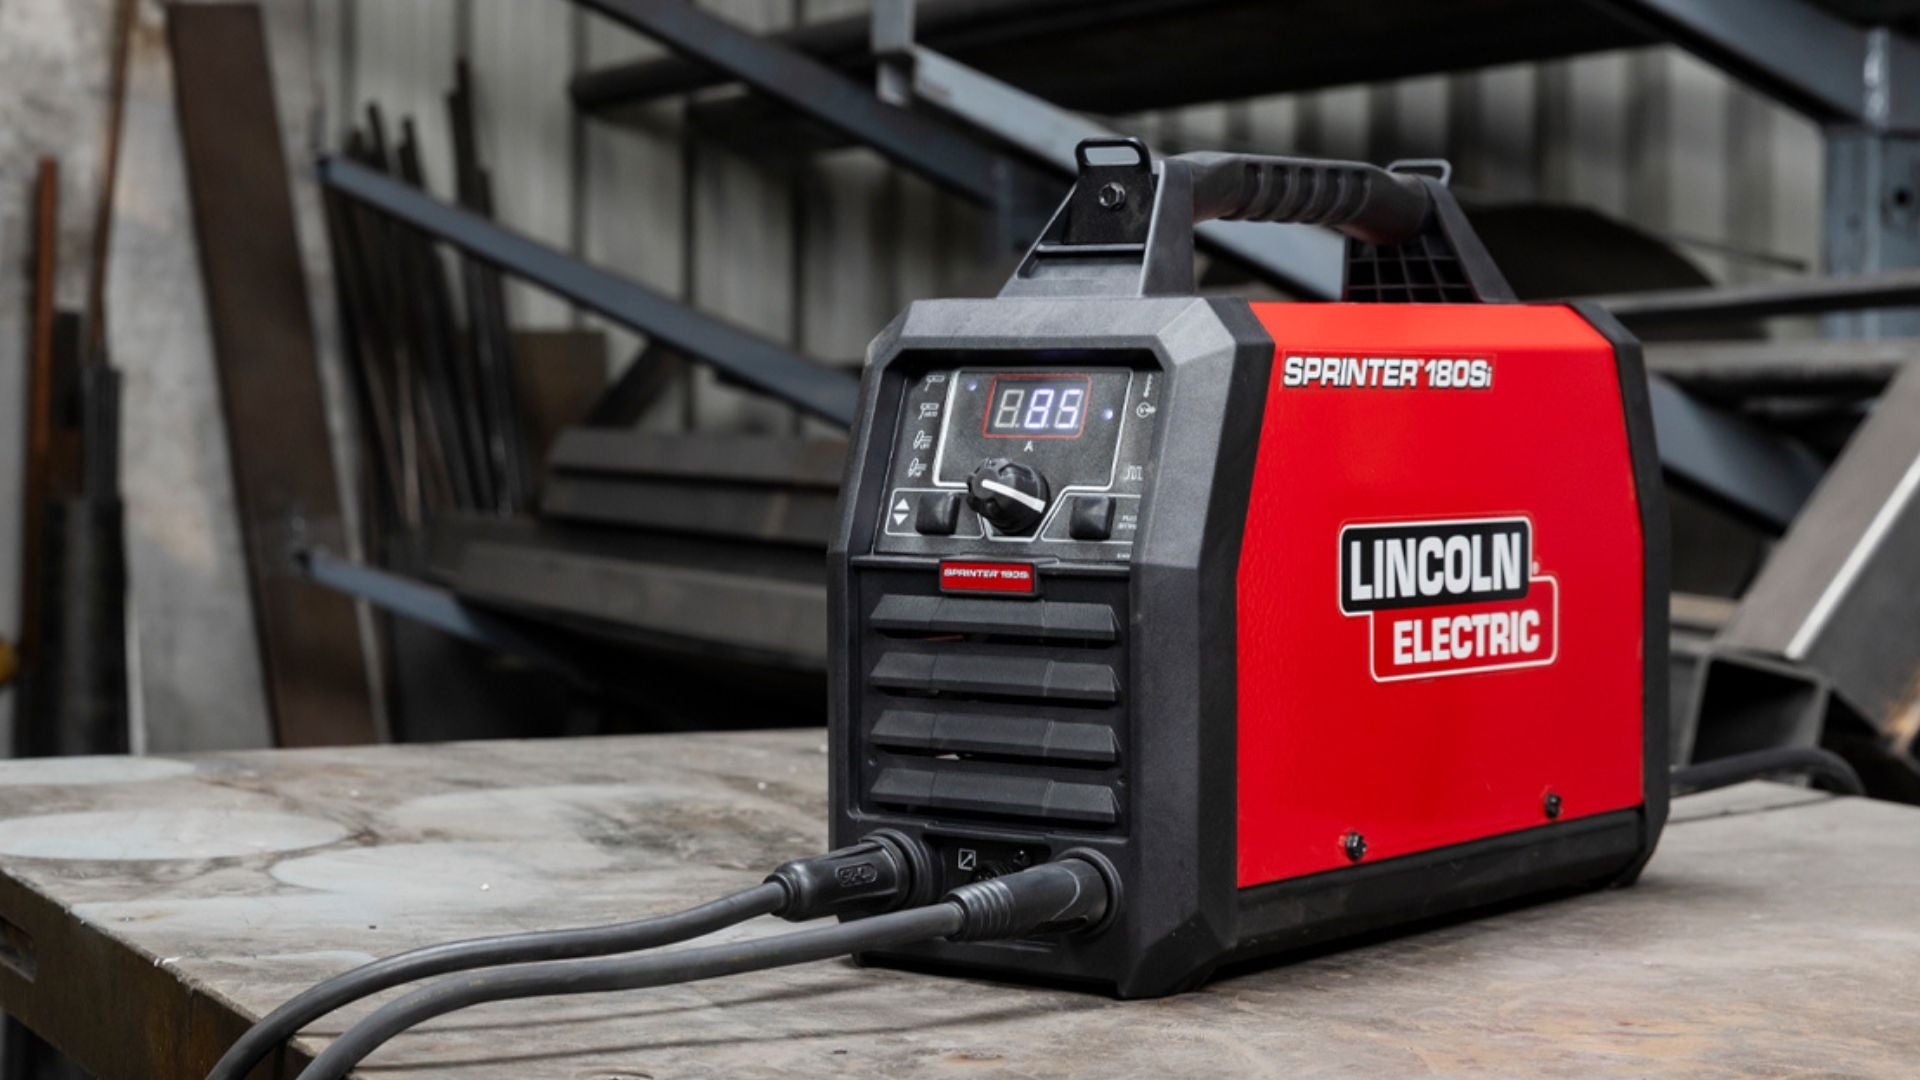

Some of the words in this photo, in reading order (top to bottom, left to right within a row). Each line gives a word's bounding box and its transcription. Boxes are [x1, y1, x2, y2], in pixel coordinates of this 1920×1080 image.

[1283, 356, 1419, 387] SPRINTER
[1424, 358, 1492, 388] 180Si
[1024, 440, 1034, 452] A
[943, 568, 999, 578] SPRINTER
[1351, 532, 1521, 601] LINCOLN
[1393, 609, 1540, 666] ELECTRIC
